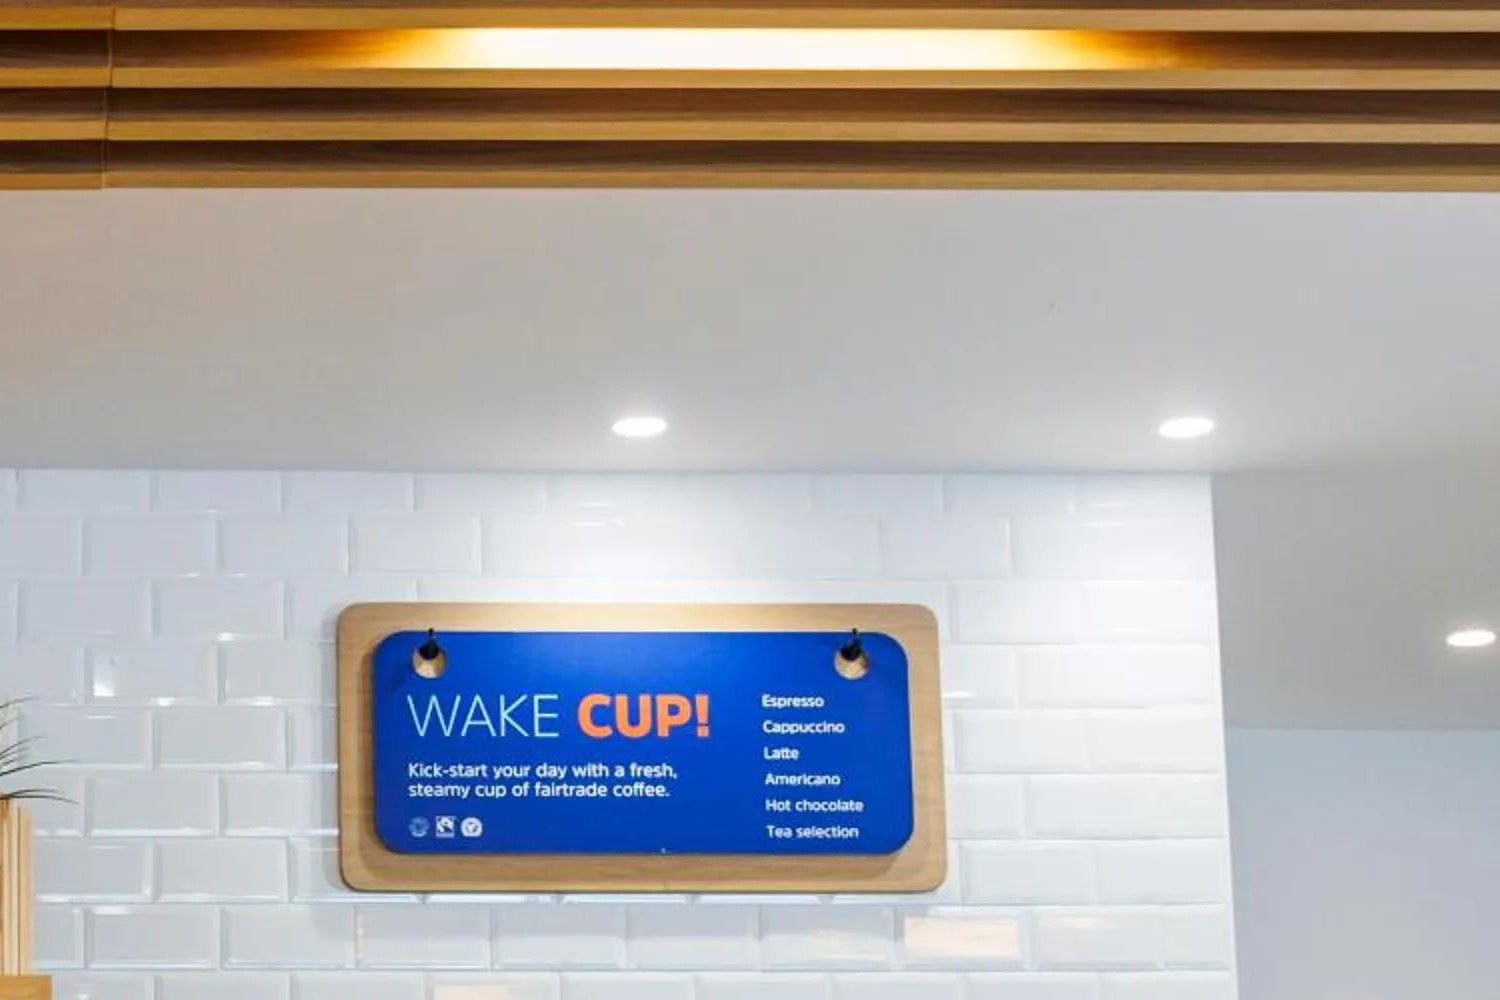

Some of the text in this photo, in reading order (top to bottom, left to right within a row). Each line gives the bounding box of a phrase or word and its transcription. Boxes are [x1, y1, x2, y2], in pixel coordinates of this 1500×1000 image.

[761, 693, 825, 709] Espresso
[407, 692, 710, 738] WAKE CUP!
[762, 719, 846, 735] Cappuccino
[763, 746, 800, 760] Latte
[408, 762, 678, 780] Kick-start your day with a fresh,
[765, 772, 841, 786] Americano
[408, 781, 670, 800] steamy cup of fairtrade coffee.
[765, 798, 864, 812] Hot chocolate
[766, 824, 859, 839] Tea selection
